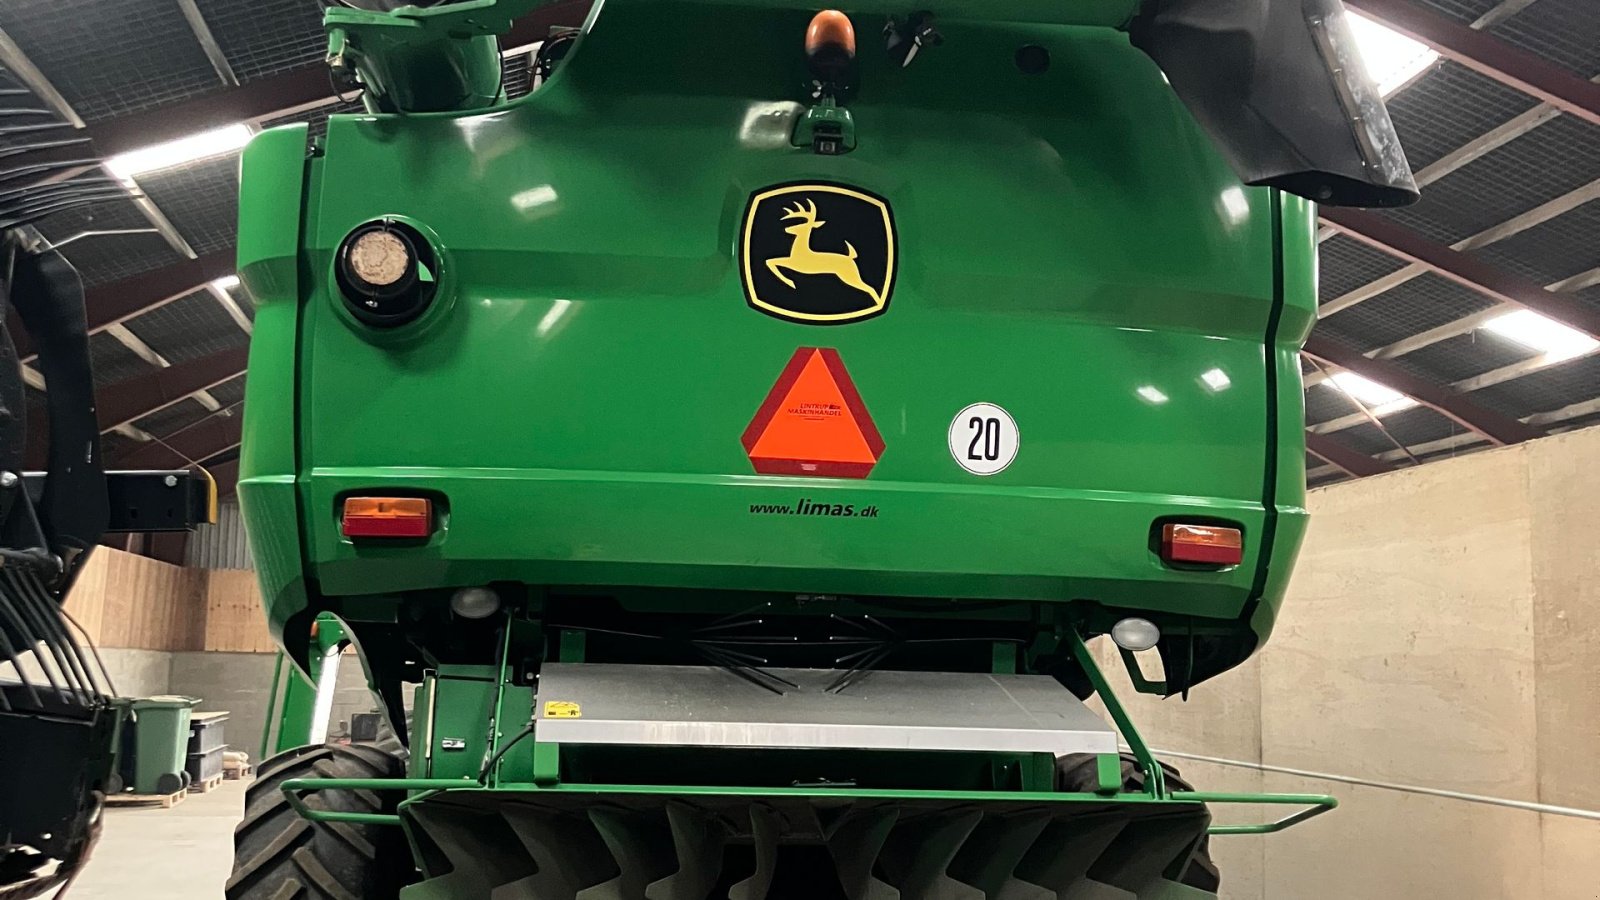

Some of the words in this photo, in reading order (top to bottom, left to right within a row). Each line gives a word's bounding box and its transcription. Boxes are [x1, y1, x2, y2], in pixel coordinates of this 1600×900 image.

[787, 408, 841, 416] MASKINHANDEL
[968, 416, 1000, 460] 20
[749, 498, 879, 518] www.limas.dk
